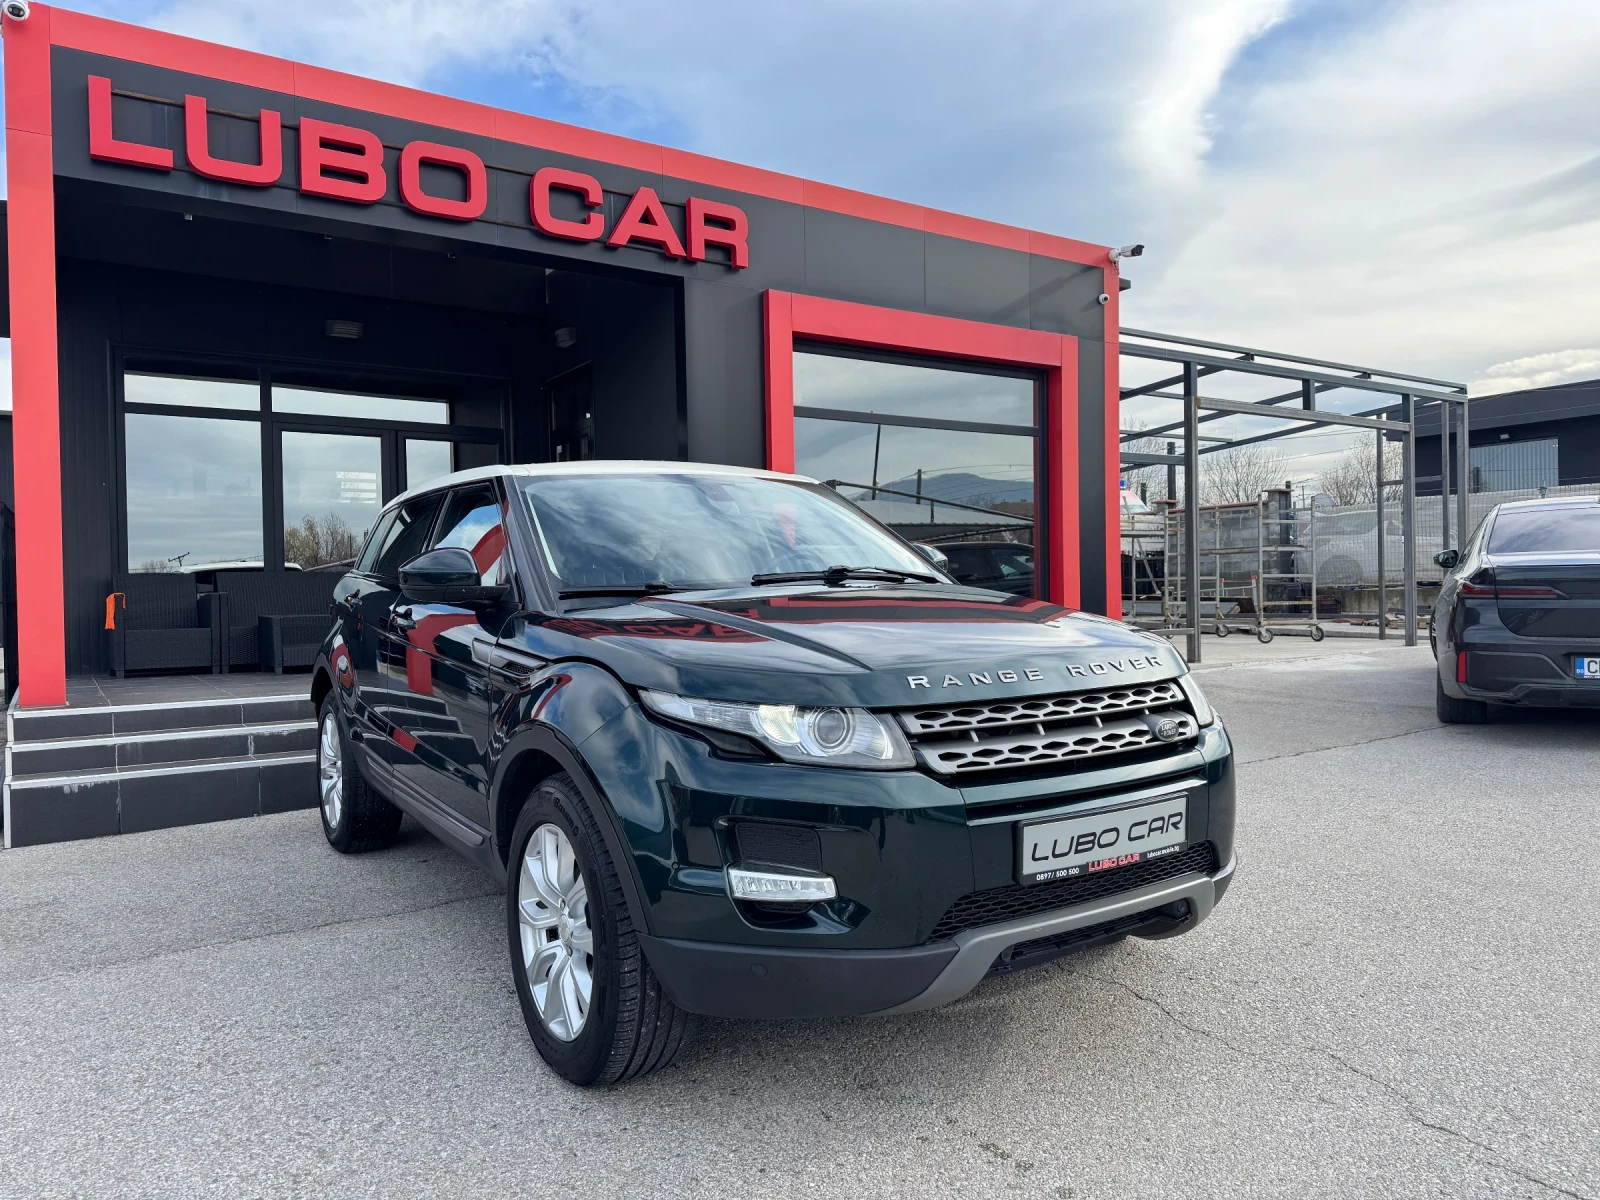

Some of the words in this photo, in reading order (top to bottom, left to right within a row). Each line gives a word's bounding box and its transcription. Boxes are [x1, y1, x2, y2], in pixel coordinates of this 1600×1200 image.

[87, 74, 488, 222] LUBO
[529, 167, 749, 270] CAR
[906, 667, 1044, 689] RANGE
[1066, 656, 1163, 677] ROVER
[1587, 660, 1600, 674] C
[1032, 827, 1119, 861] LUBO
[1127, 811, 1183, 842] CAR
[1056, 869, 1067, 878] 500
[1068, 867, 1080, 875] 500
[1088, 859, 1117, 871] LUBO
[1118, 853, 1140, 865] CAR
